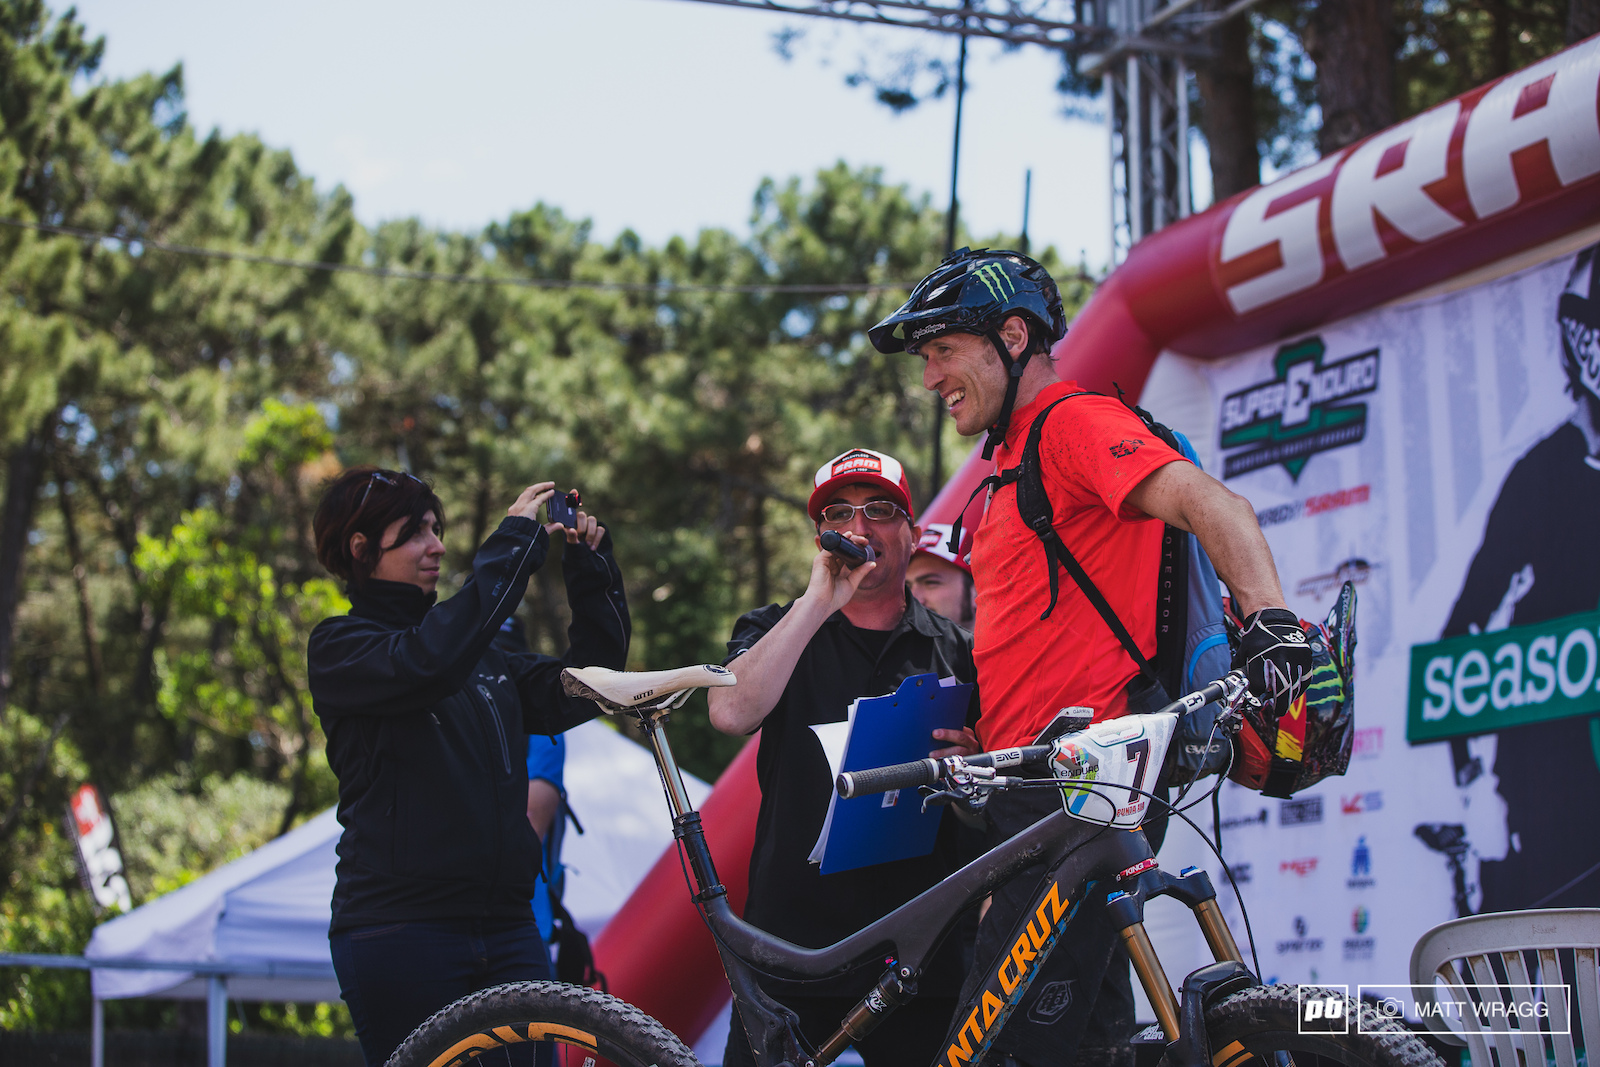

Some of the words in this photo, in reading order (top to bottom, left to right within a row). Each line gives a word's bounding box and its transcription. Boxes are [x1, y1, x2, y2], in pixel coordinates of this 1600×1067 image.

[834, 459, 879, 474] SRAM
[1421, 626, 1600, 722] seaso
[633, 689, 654, 700] WTB
[1126, 739, 1150, 805] 7
[1125, 862, 1145, 876] KING
[937, 989, 1005, 1067] NTA
[998, 881, 1070, 996] CRUZ
